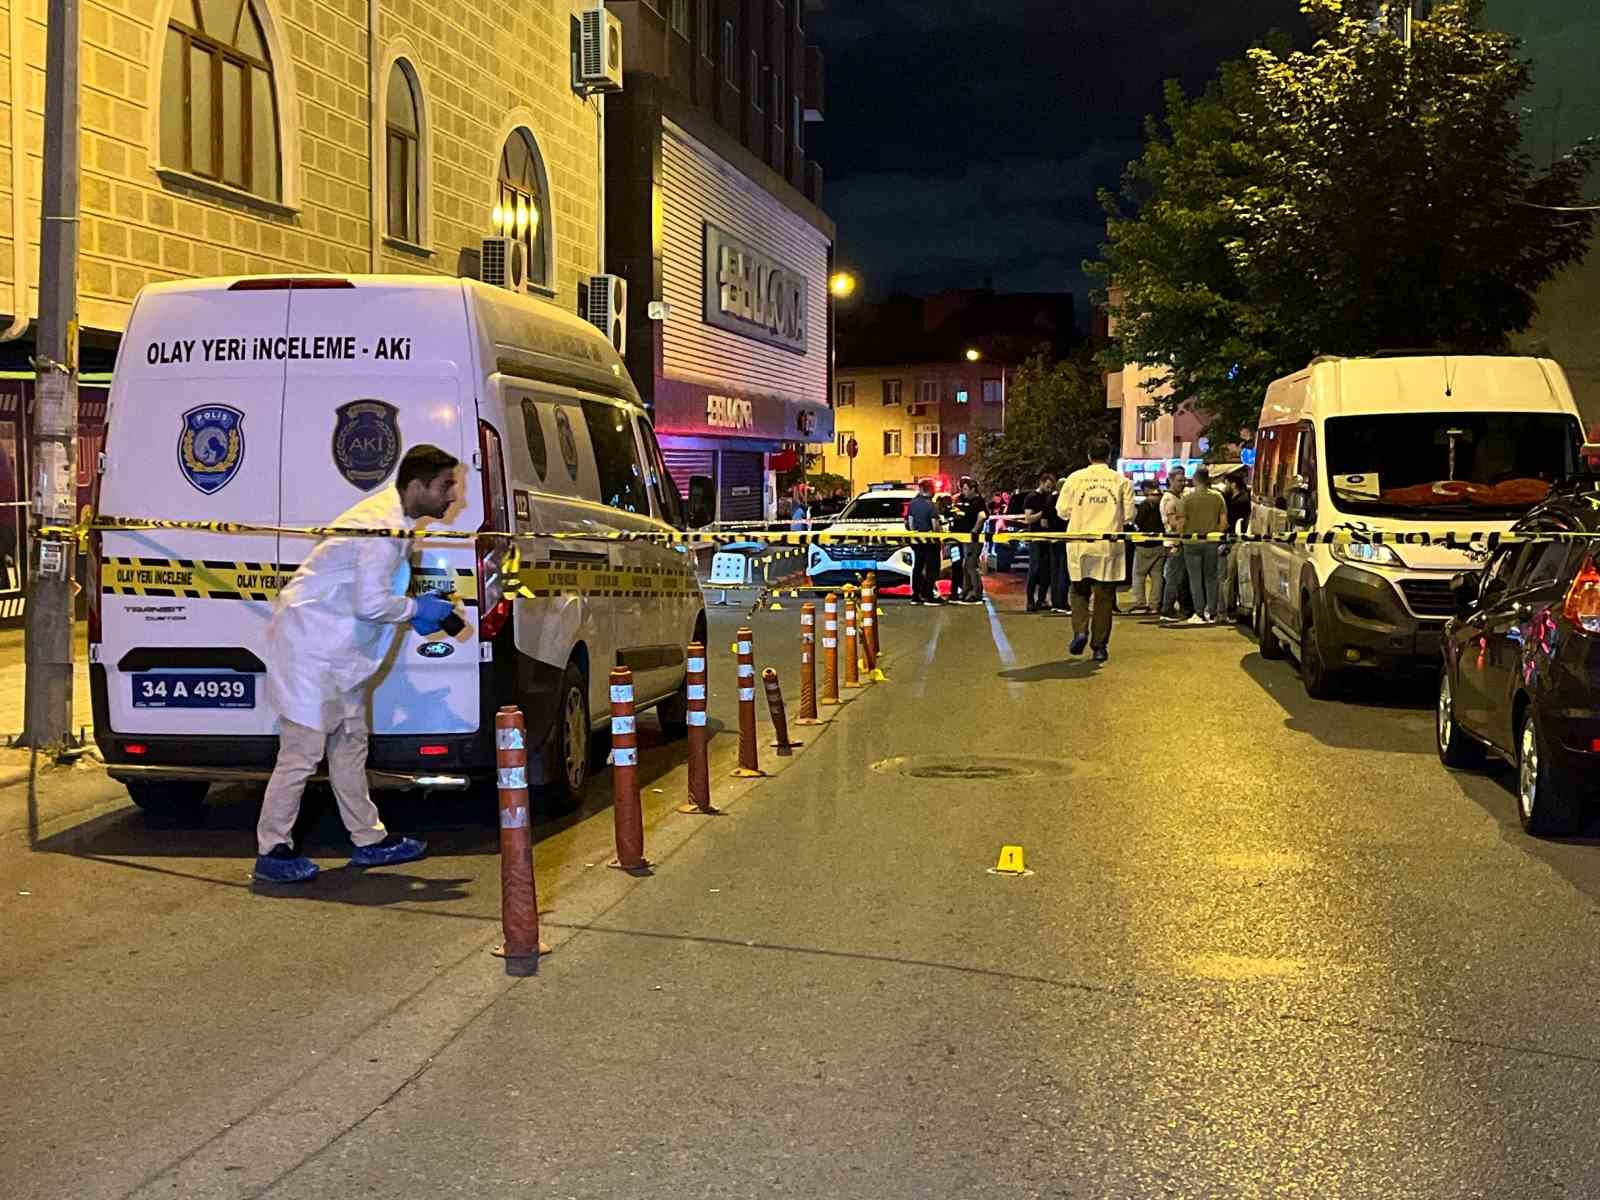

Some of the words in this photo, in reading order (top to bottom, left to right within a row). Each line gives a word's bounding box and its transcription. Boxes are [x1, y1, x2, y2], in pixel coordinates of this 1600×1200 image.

[147, 340, 195, 364] OLAY
[237, 574, 257, 588] OLAY
[142, 681, 167, 697] 34
[173, 681, 188, 697] A
[194, 681, 245, 698] 4939
